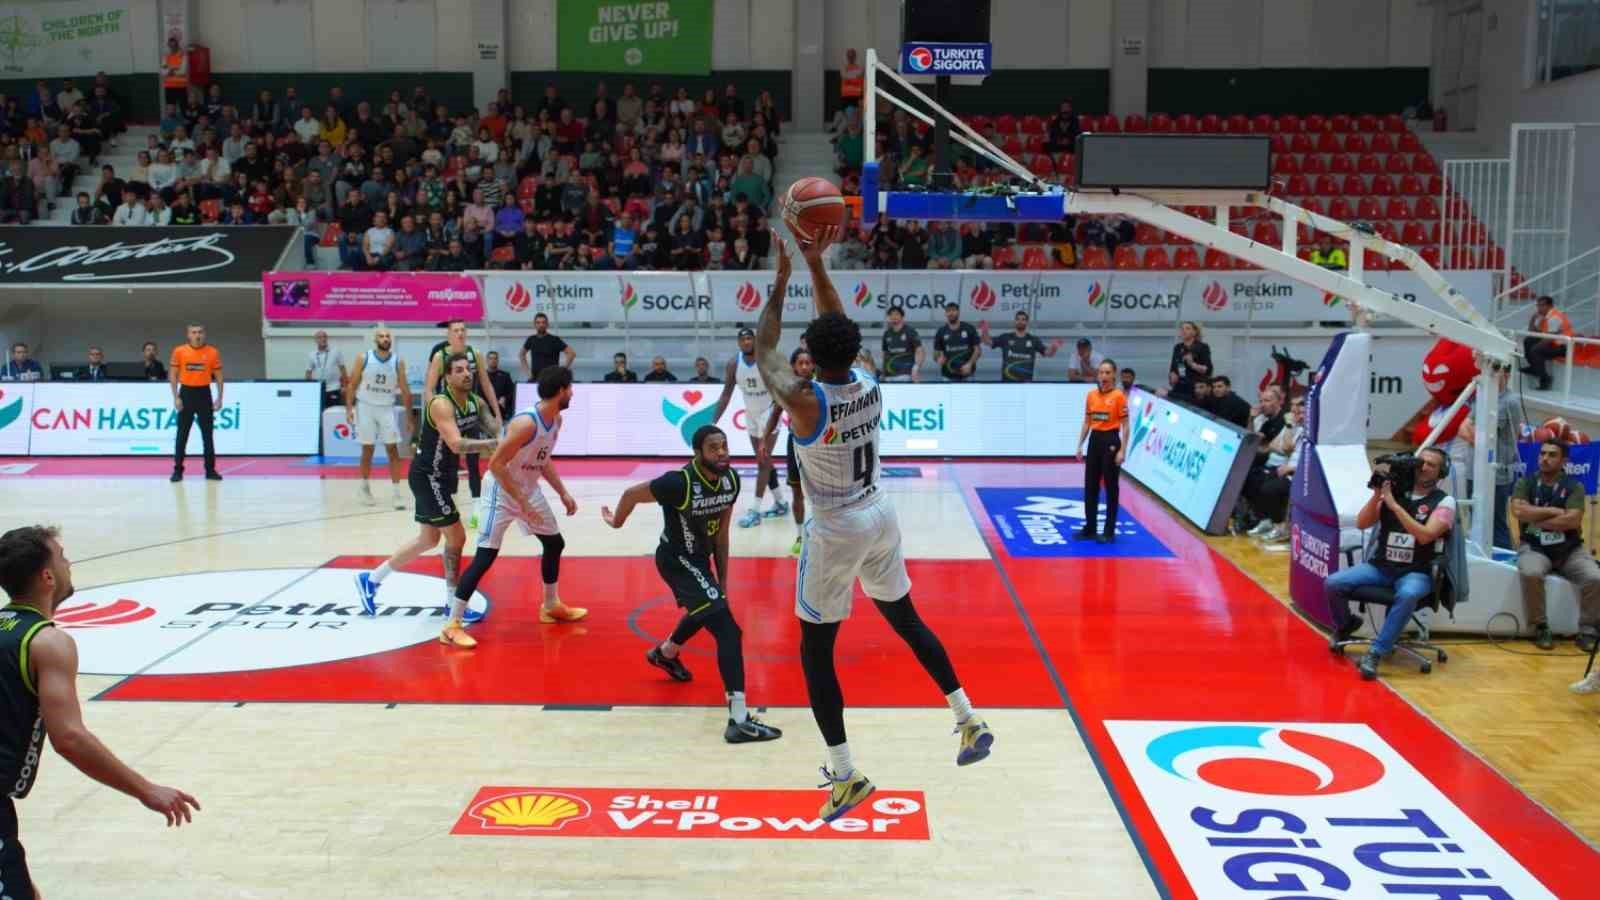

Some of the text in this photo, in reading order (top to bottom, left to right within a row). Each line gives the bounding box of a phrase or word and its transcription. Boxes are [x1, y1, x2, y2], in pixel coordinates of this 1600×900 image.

[597, 1, 670, 24] NEVER
[50, 31, 76, 41] THE
[588, 20, 679, 44] GIVE UP!
[535, 284, 593, 299] Petkim
[1233, 281, 1294, 298] Petkim
[642, 295, 712, 311] SOCAR
[876, 294, 947, 310] SOCAR
[1110, 294, 1180, 310] SOCAR
[375, 373, 387, 384] 23
[31, 402, 241, 431] CAN HASTAESİ
[852, 441, 875, 488] 4
[1393, 535, 1409, 545] TV
[159, 619, 349, 631] SPOR
[609, 794, 719, 811] Shell
[609, 809, 901, 834] V-Power
